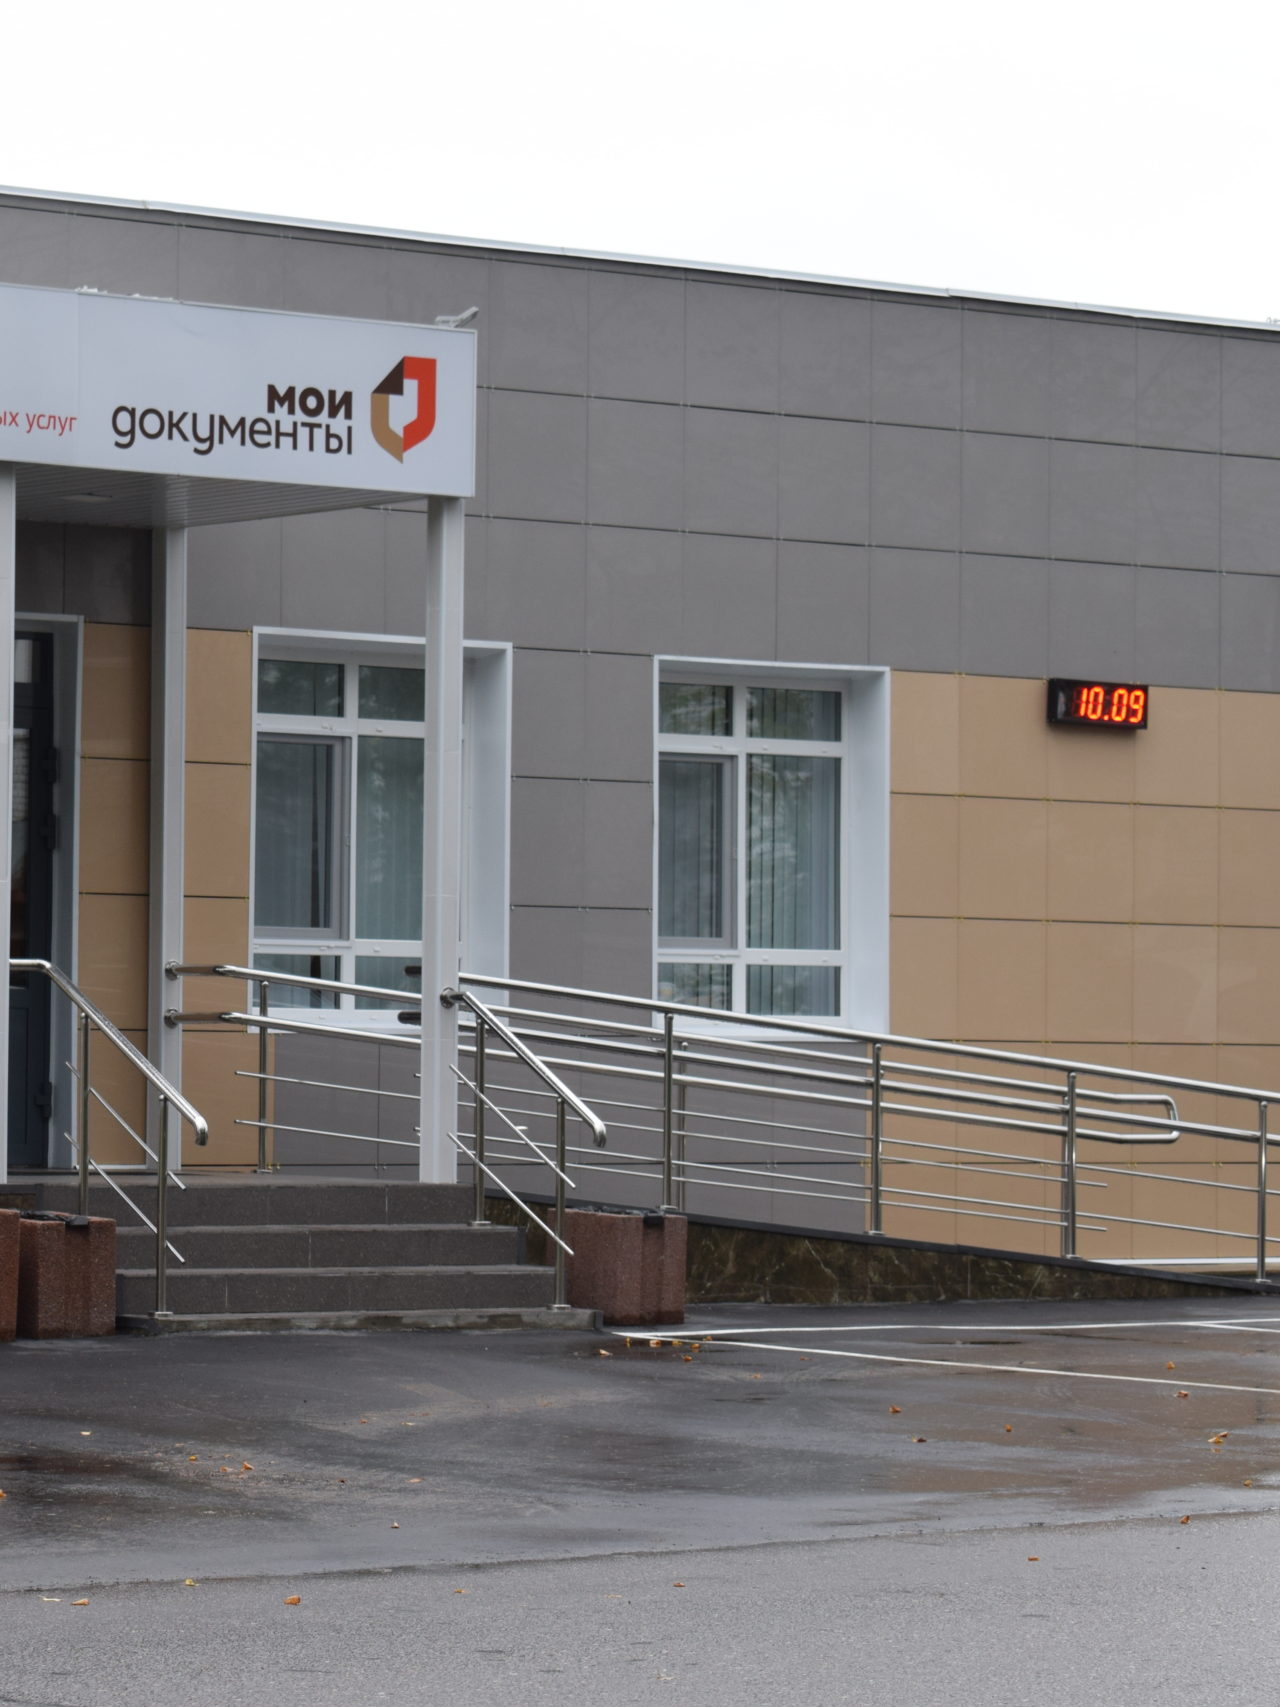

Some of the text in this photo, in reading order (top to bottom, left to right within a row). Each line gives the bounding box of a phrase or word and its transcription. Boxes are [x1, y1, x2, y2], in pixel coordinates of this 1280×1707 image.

[266, 383, 354, 421] мои
[26, 412, 78, 437] услуг
[111, 404, 354, 456] документы
[1079, 685, 1146, 724] 10.09
